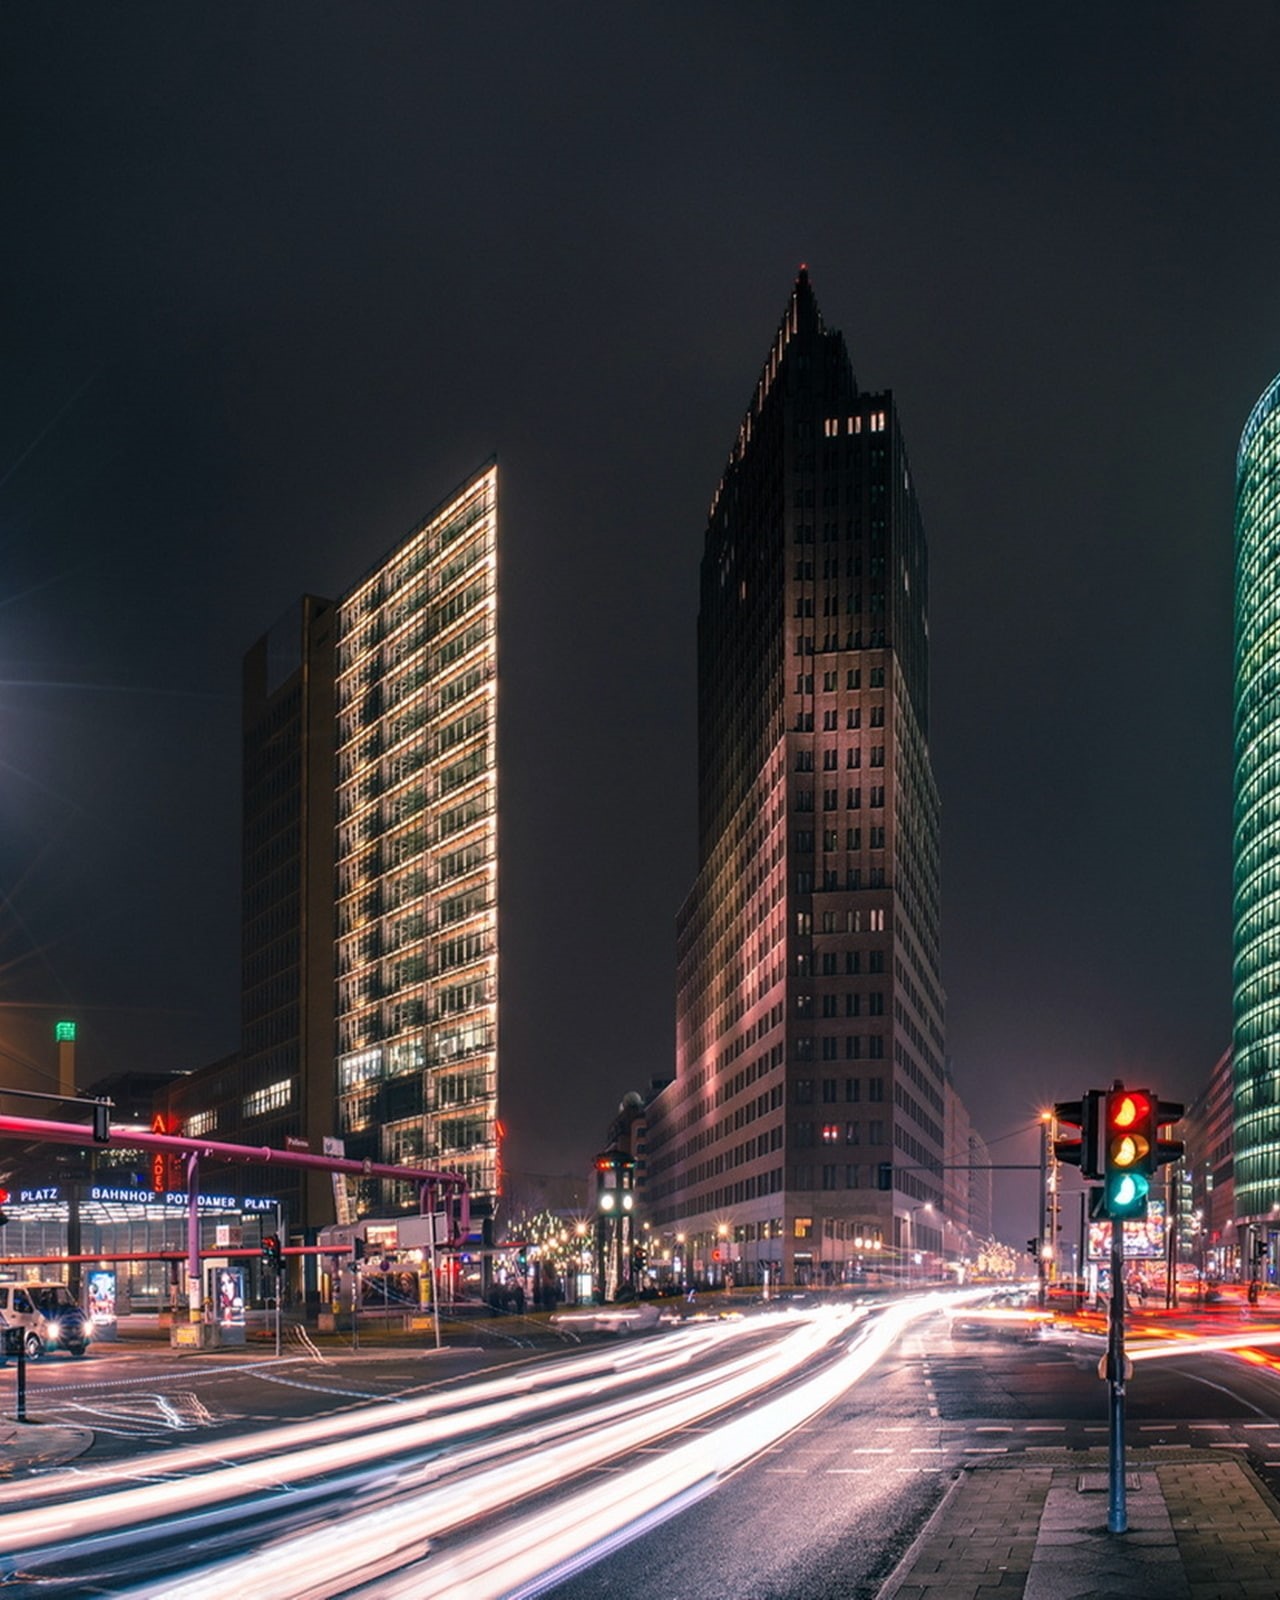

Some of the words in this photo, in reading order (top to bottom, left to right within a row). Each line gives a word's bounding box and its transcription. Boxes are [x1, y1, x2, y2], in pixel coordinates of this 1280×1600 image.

[21, 1188, 58, 1201] PLATZ
[91, 1187, 156, 1202] BAHNHOF
[166, 1193, 236, 1208] POTDAMER
